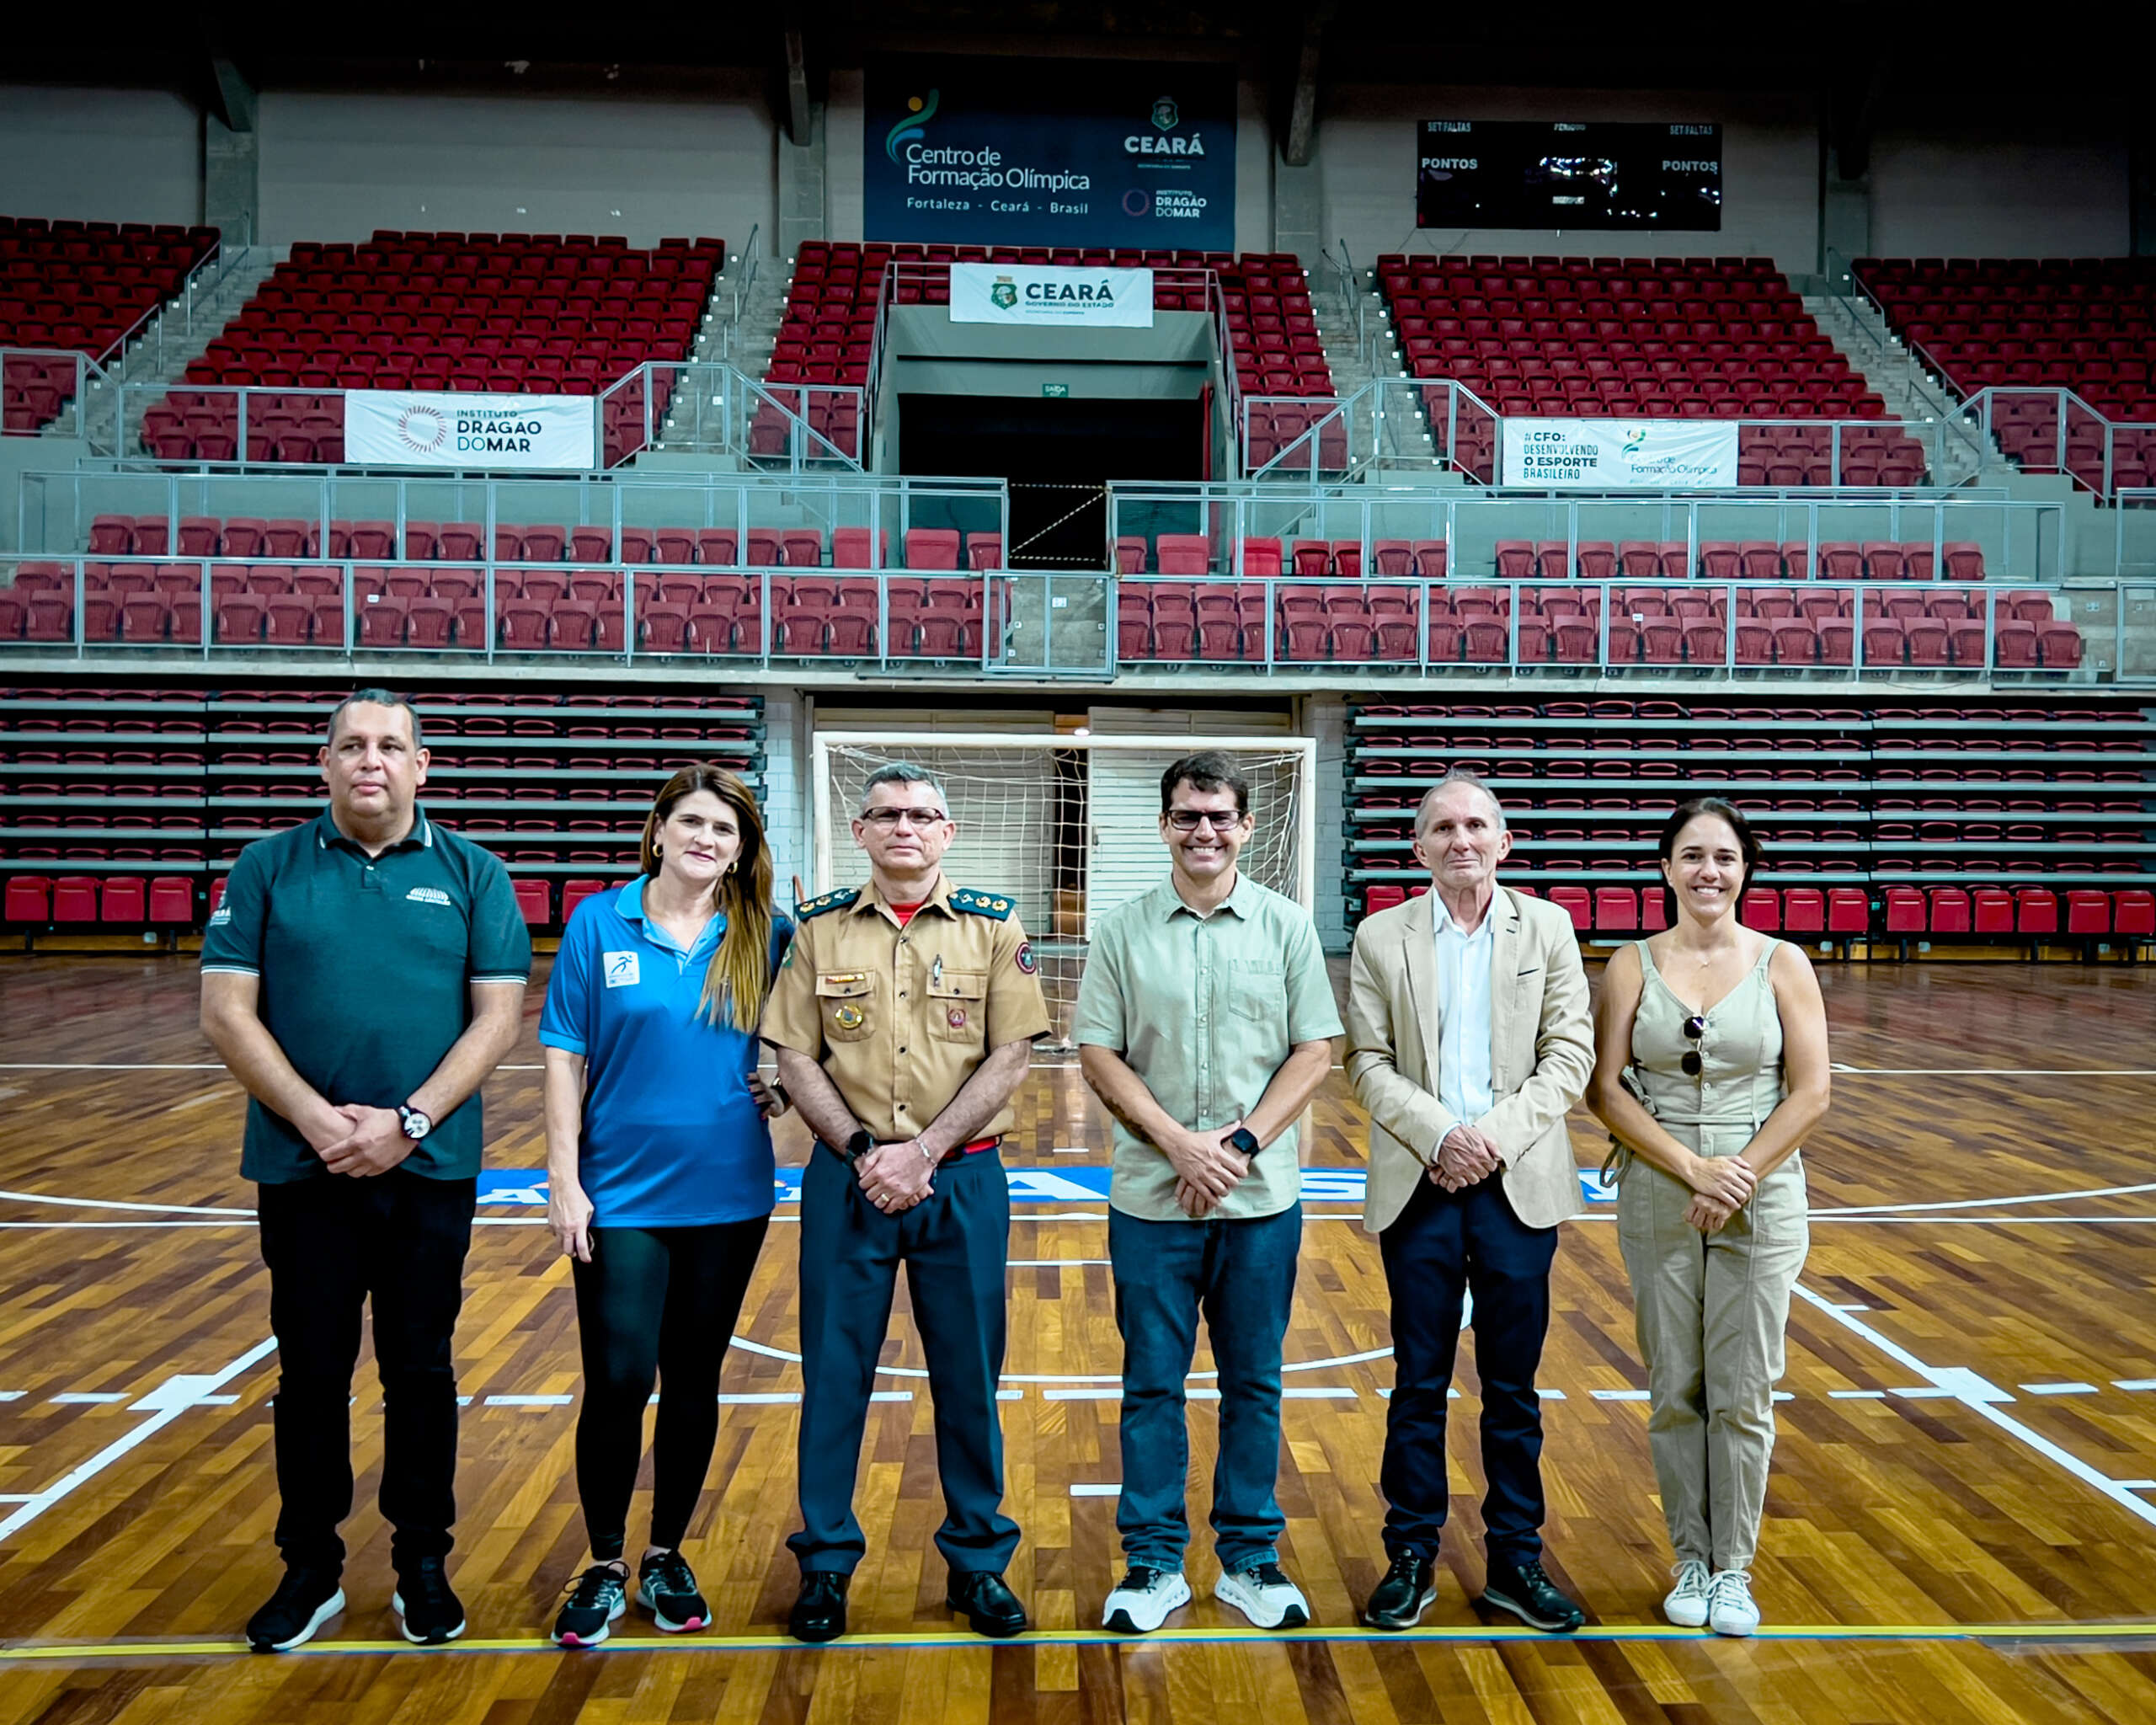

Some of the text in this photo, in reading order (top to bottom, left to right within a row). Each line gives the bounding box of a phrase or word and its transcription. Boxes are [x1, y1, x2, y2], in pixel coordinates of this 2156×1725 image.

[1124, 132, 1204, 155] CEARÁ
[906, 143, 1001, 166] Centro de
[1422, 158, 1478, 169] PONTOS
[1662, 160, 1718, 172] PONTOS
[908, 164, 1090, 192] Formação Olímpica
[907, 197, 970, 211] Fortaleza
[990, 200, 1029, 212] Ceará
[1050, 201, 1088, 214] Brasil
[1155, 195, 1207, 207] DRAGÃO
[1026, 279, 1113, 301] CEARÁ
[456, 409, 518, 418] INSTITUTO
[457, 416, 542, 435] DRAGÃO
[1524, 444, 1598, 456] DESENVOLVENDO
[1524, 457, 1598, 467] O ESPORTE
[1524, 467, 1580, 479] BRASILEIRO
